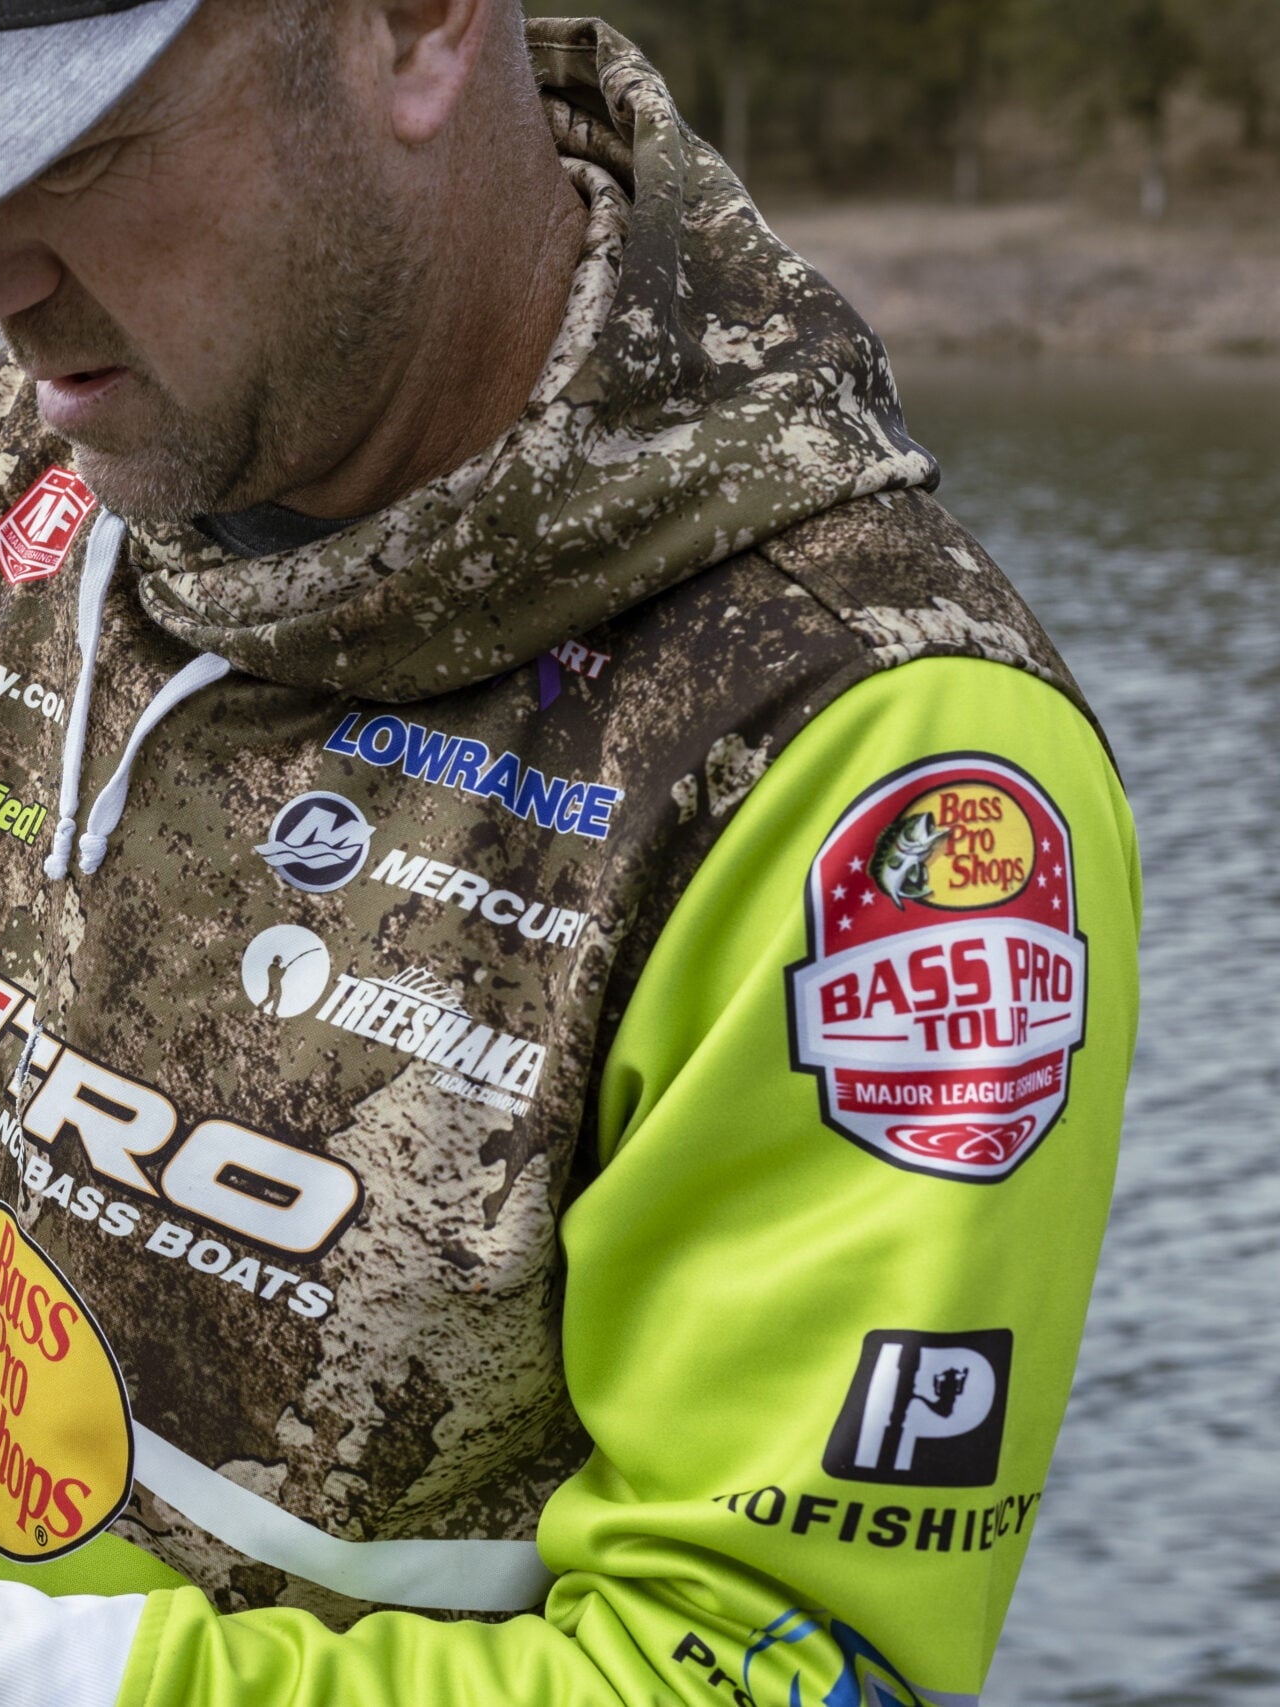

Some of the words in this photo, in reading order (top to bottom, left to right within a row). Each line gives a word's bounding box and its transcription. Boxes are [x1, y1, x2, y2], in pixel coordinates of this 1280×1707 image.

[324, 712, 618, 840] LOWRANCE
[937, 792, 1003, 827] Bass
[944, 824, 995, 856] Pro
[949, 853, 1025, 892] Shops
[820, 938, 991, 1024] BASS
[1005, 937, 1073, 1003] PRO
[913, 1007, 1027, 1051] TOUR
[476, 1088, 530, 1118] COMPAN
[855, 1083, 932, 1105] MAJOR
[940, 1081, 1015, 1105] LEAGUE
[24, 1155, 141, 1236] BASS
[145, 1221, 335, 1318] BOATS
